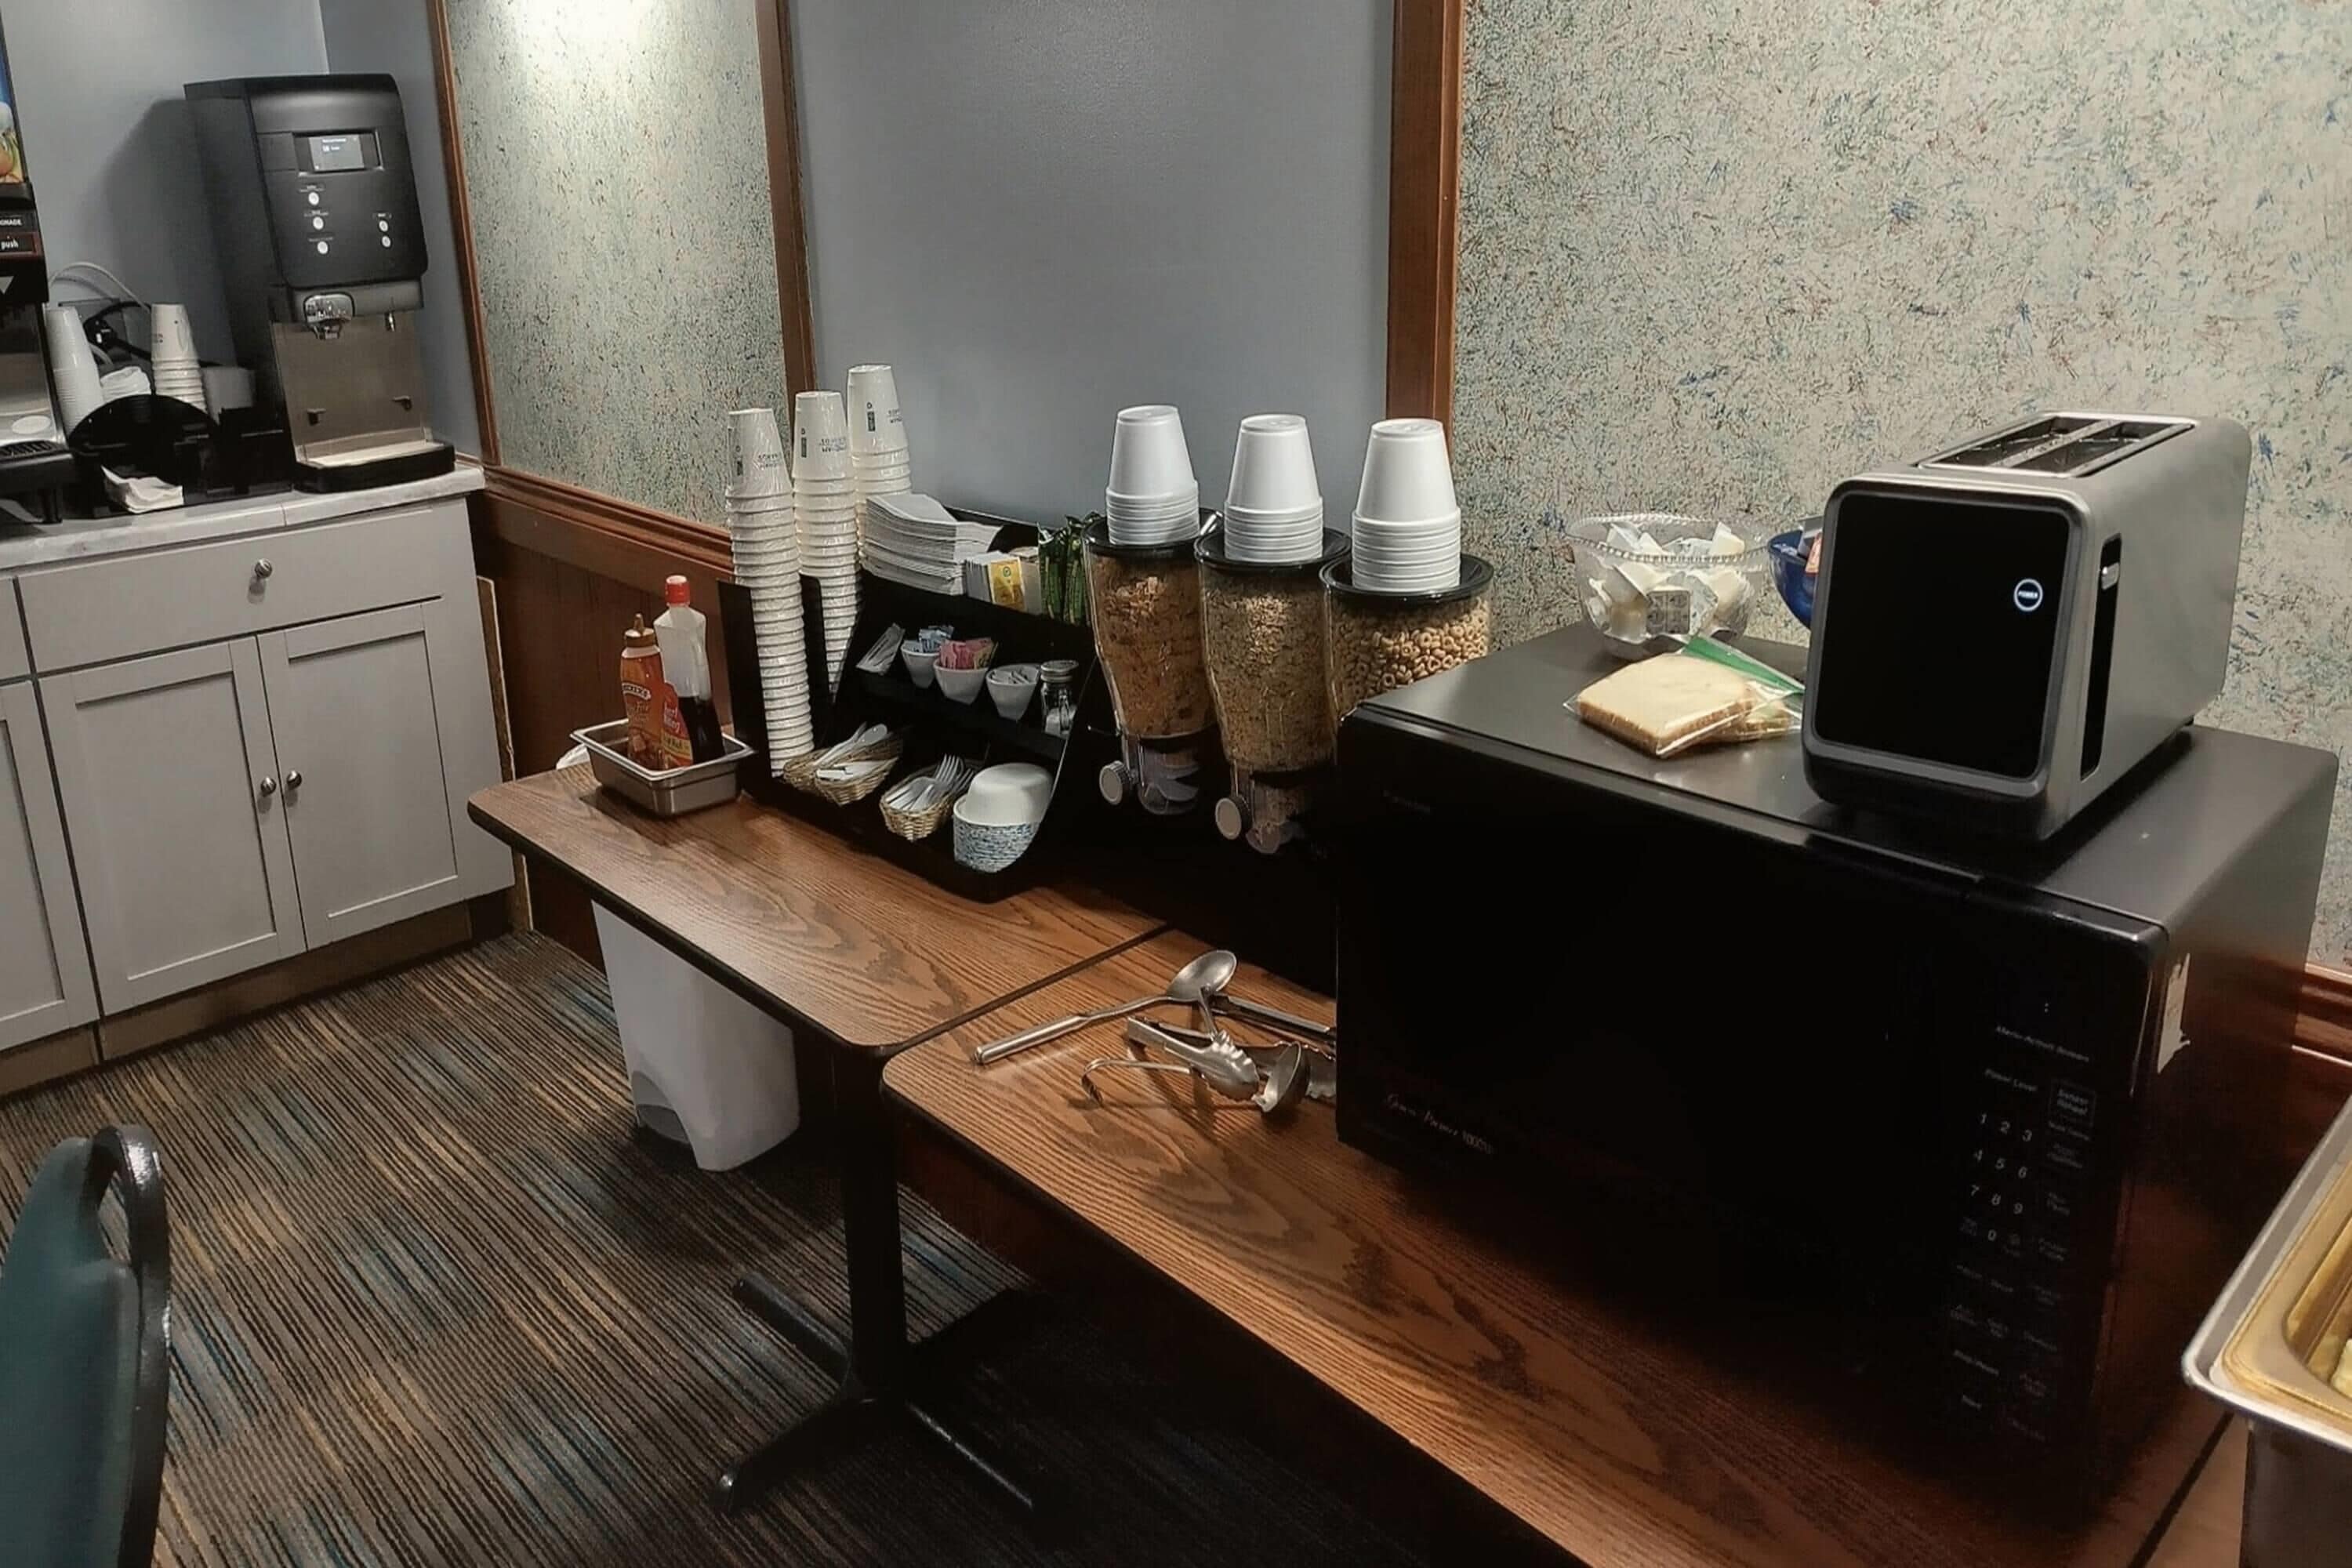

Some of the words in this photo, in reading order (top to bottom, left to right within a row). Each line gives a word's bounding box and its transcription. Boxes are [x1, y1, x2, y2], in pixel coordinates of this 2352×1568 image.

[1, 238, 19, 250] push
[1980, 1112, 1988, 1125] 1
[1999, 1120, 2011, 1134] 2
[2021, 1128, 2033, 1142] 3
[1973, 1148, 1984, 1162] 4
[1994, 1157, 2005, 1171] 5
[2017, 1165, 2028, 1179] 6
[1970, 1184, 1980, 1197] 7
[1990, 1192, 2002, 1207] 8
[2013, 1202, 2024, 1215] 9
[1987, 1229, 1998, 1242] 0
